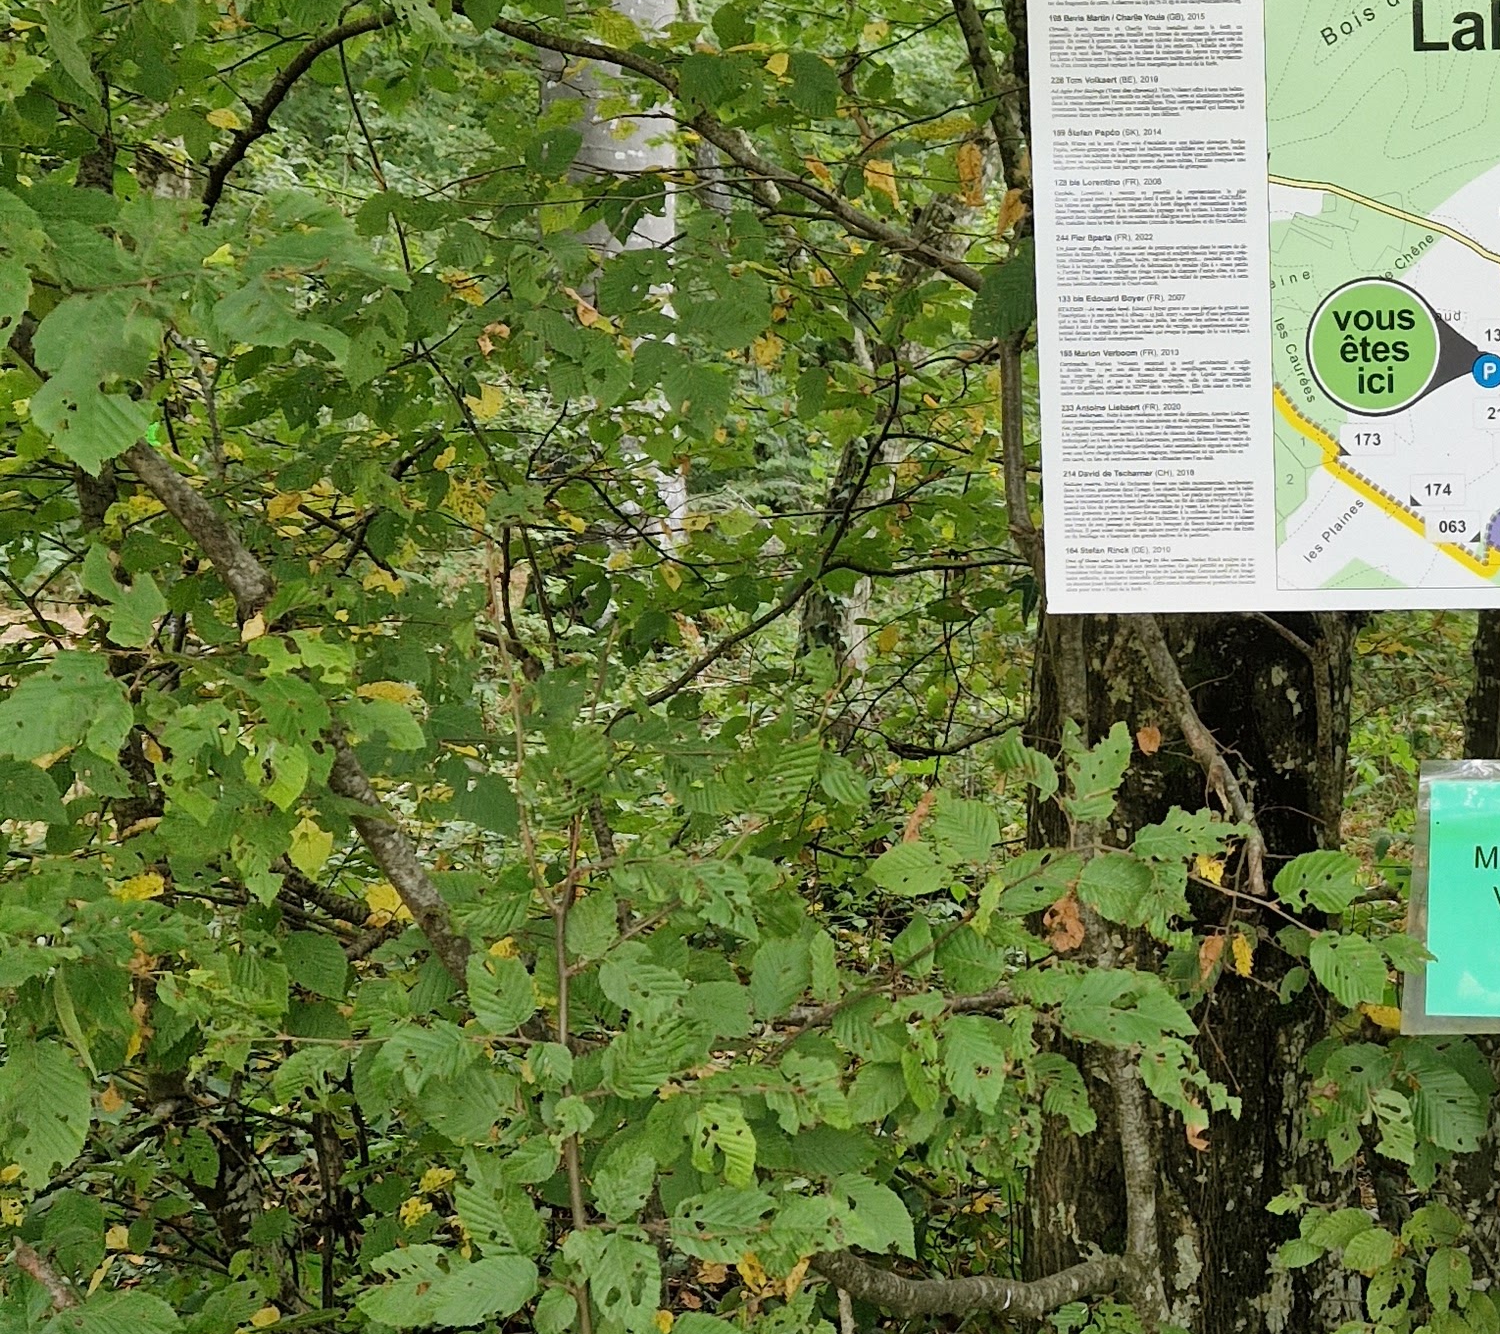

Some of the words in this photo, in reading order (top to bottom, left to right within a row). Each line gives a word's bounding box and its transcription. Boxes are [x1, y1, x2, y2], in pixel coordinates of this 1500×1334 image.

[1320, 7, 1376, 46] Bois
[1395, 233, 1434, 270] Chêne
[1333, 309, 1415, 331] vous
[1275, 317, 1288, 339] les
[1286, 344, 1315, 403] Caurées
[1340, 335, 1409, 362] êtes
[1358, 366, 1394, 394] ici
[1483, 363, 1496, 380] P
[1355, 434, 1381, 445] 173
[1286, 475, 1294, 484] 2
[1425, 484, 1452, 496] 174
[1303, 545, 1323, 563] les
[1322, 498, 1364, 542] Plaines
[1439, 520, 1466, 533] 063
